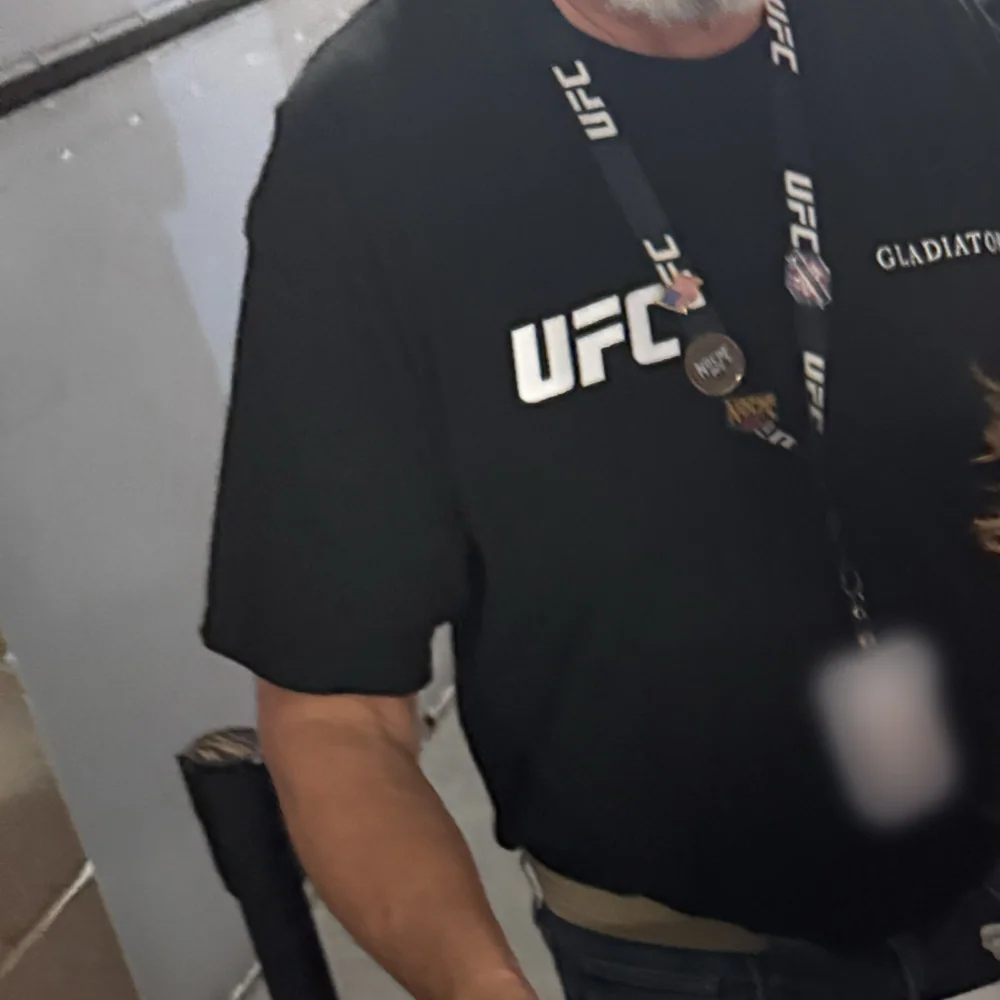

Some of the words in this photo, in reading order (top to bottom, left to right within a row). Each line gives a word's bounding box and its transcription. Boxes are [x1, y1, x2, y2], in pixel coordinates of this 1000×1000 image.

[552, 60, 619, 141] UFC
[784, 169, 819, 255] UFC
[642, 233, 706, 309] FC
[511, 283, 681, 404] UFC
